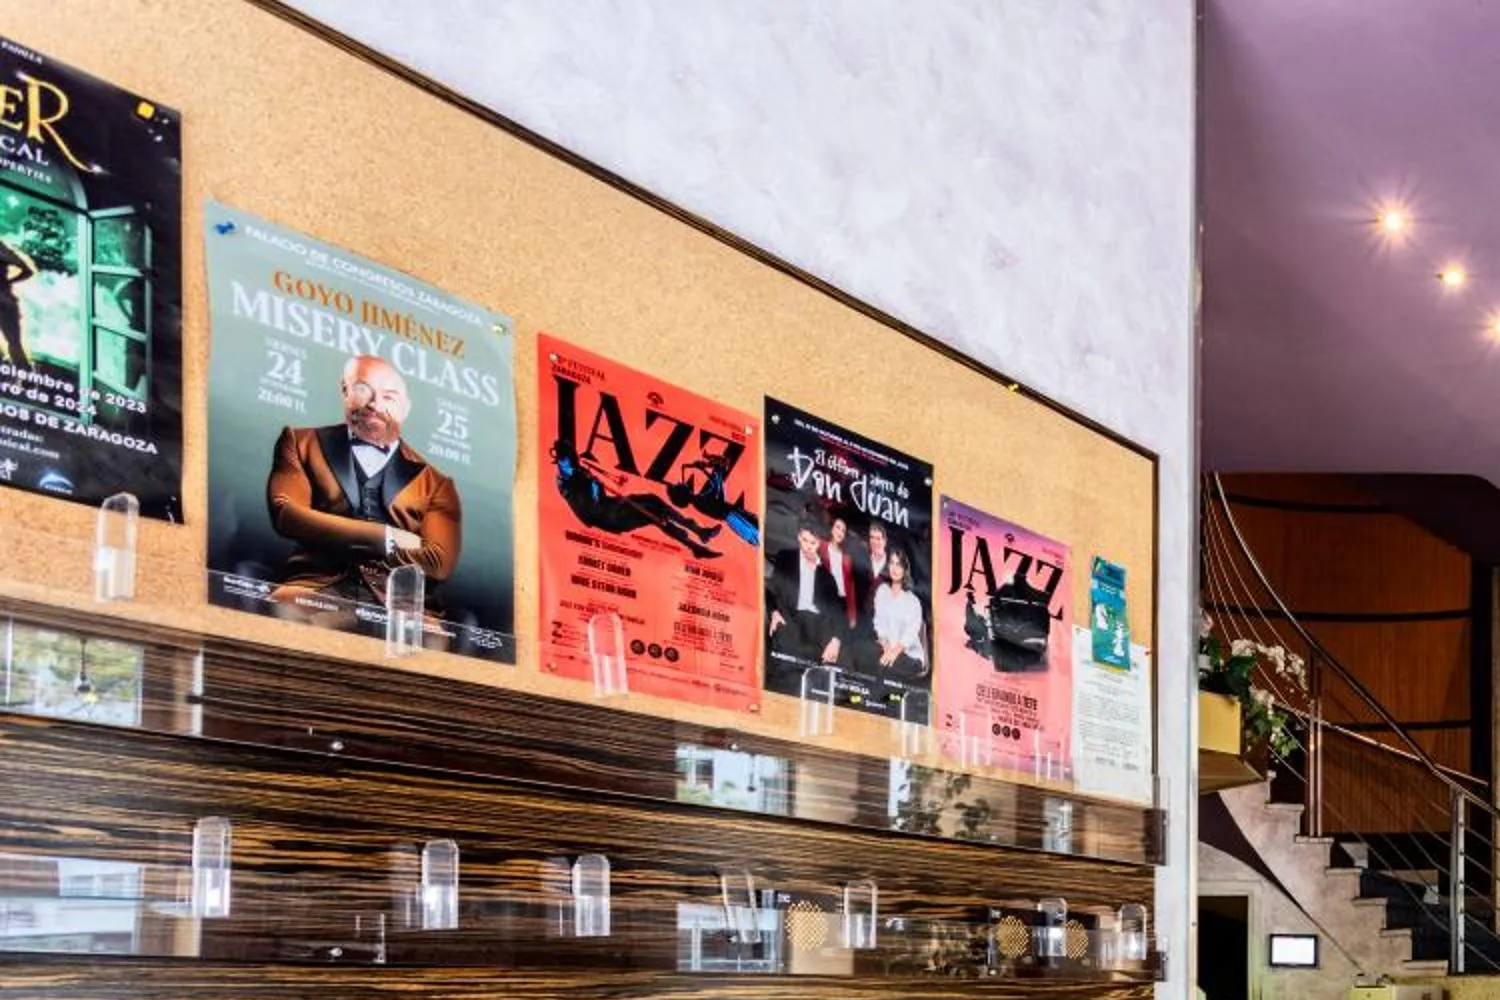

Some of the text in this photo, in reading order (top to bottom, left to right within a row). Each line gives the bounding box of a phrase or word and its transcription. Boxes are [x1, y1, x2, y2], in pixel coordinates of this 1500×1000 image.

[230, 280, 499, 407] MISERY CLASS
[274, 270, 466, 361] GOYO JIMÉNEZ
[266, 350, 303, 385] 24
[35, 411, 60, 429] DE
[63, 419, 159, 455] ZARAGOZA
[54, 393, 97, 416] 2024
[105, 391, 149, 415] 2023
[437, 409, 470, 440] 25
[552, 374, 748, 512] JAZZ
[786, 445, 910, 530] Don Juan
[947, 525, 1065, 621] JAZZ
